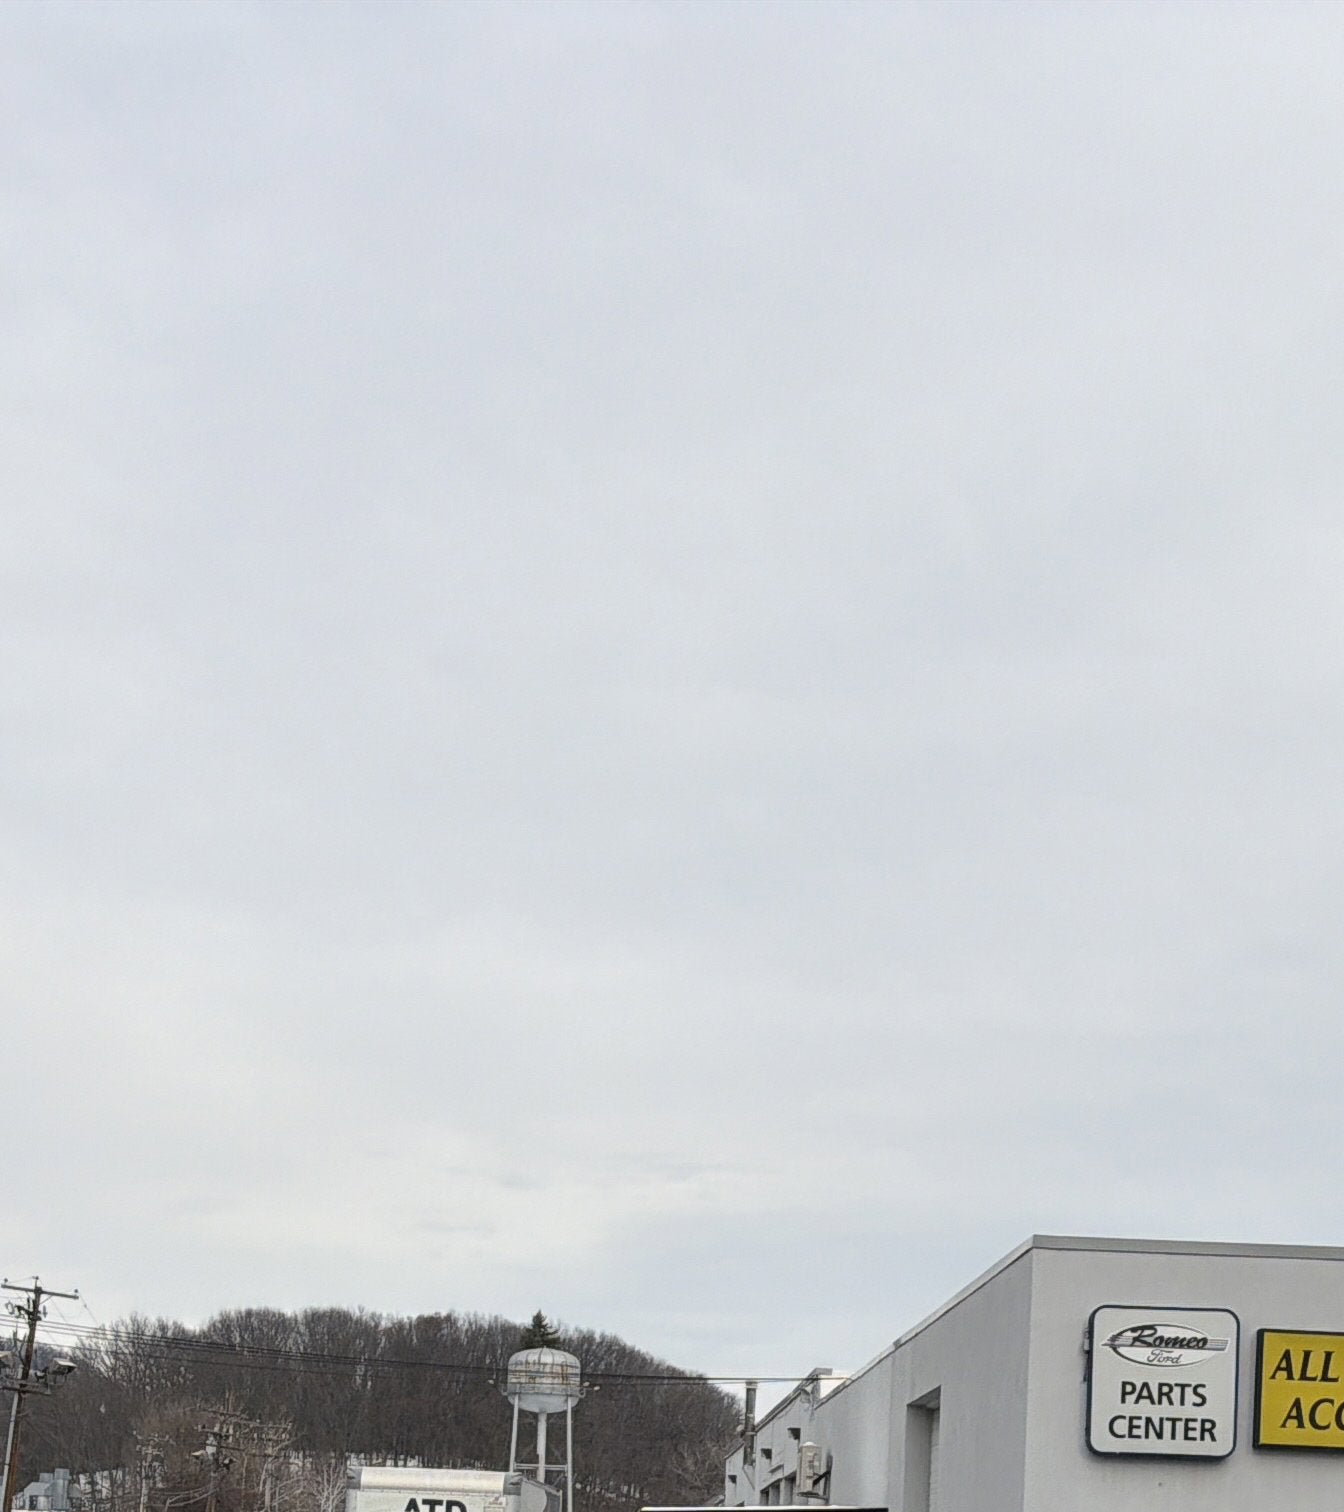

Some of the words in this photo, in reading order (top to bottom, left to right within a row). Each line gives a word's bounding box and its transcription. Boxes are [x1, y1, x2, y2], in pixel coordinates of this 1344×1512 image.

[1129, 1325, 1209, 1349] Romeo
[1146, 1350, 1184, 1364] Ford
[1269, 1348, 1339, 1383] ALL
[1120, 1380, 1207, 1407] PARTS
[1108, 1415, 1217, 1442] CENTER
